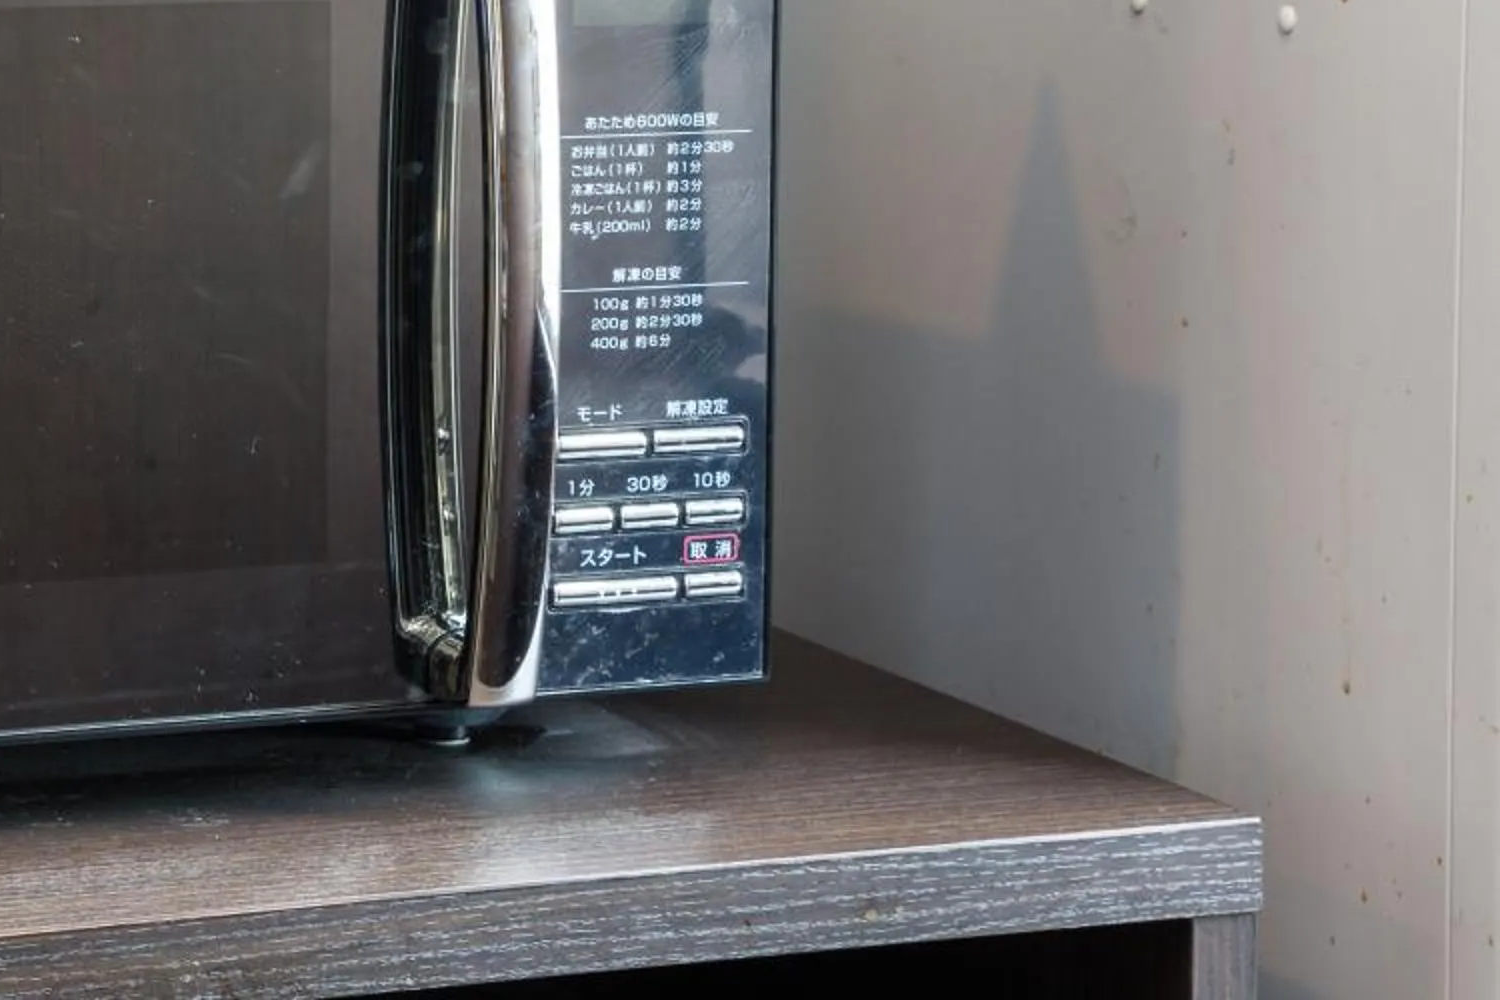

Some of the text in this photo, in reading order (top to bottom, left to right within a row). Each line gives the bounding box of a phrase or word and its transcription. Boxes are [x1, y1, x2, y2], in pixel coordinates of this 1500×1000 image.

[585, 112, 719, 130] あたため600Wの目安
[667, 140, 734, 155] 約2分30秒
[667, 161, 701, 175] 約1分
[667, 180, 702, 194] 約3分
[666, 198, 701, 212] 約2分
[665, 217, 701, 231] 約2分
[612, 266, 682, 282] 解凍の目安
[593, 294, 703, 311] 100g 約1分30秒
[591, 313, 703, 331] 200g 約2分30秒
[590, 334, 671, 350] 400g 約6分
[577, 404, 622, 421] モード
[666, 399, 729, 418] 解凍設定
[568, 479, 595, 496] 1分
[627, 474, 668, 493] 30秒
[694, 471, 731, 488] 10秒
[579, 546, 647, 567] スタート
